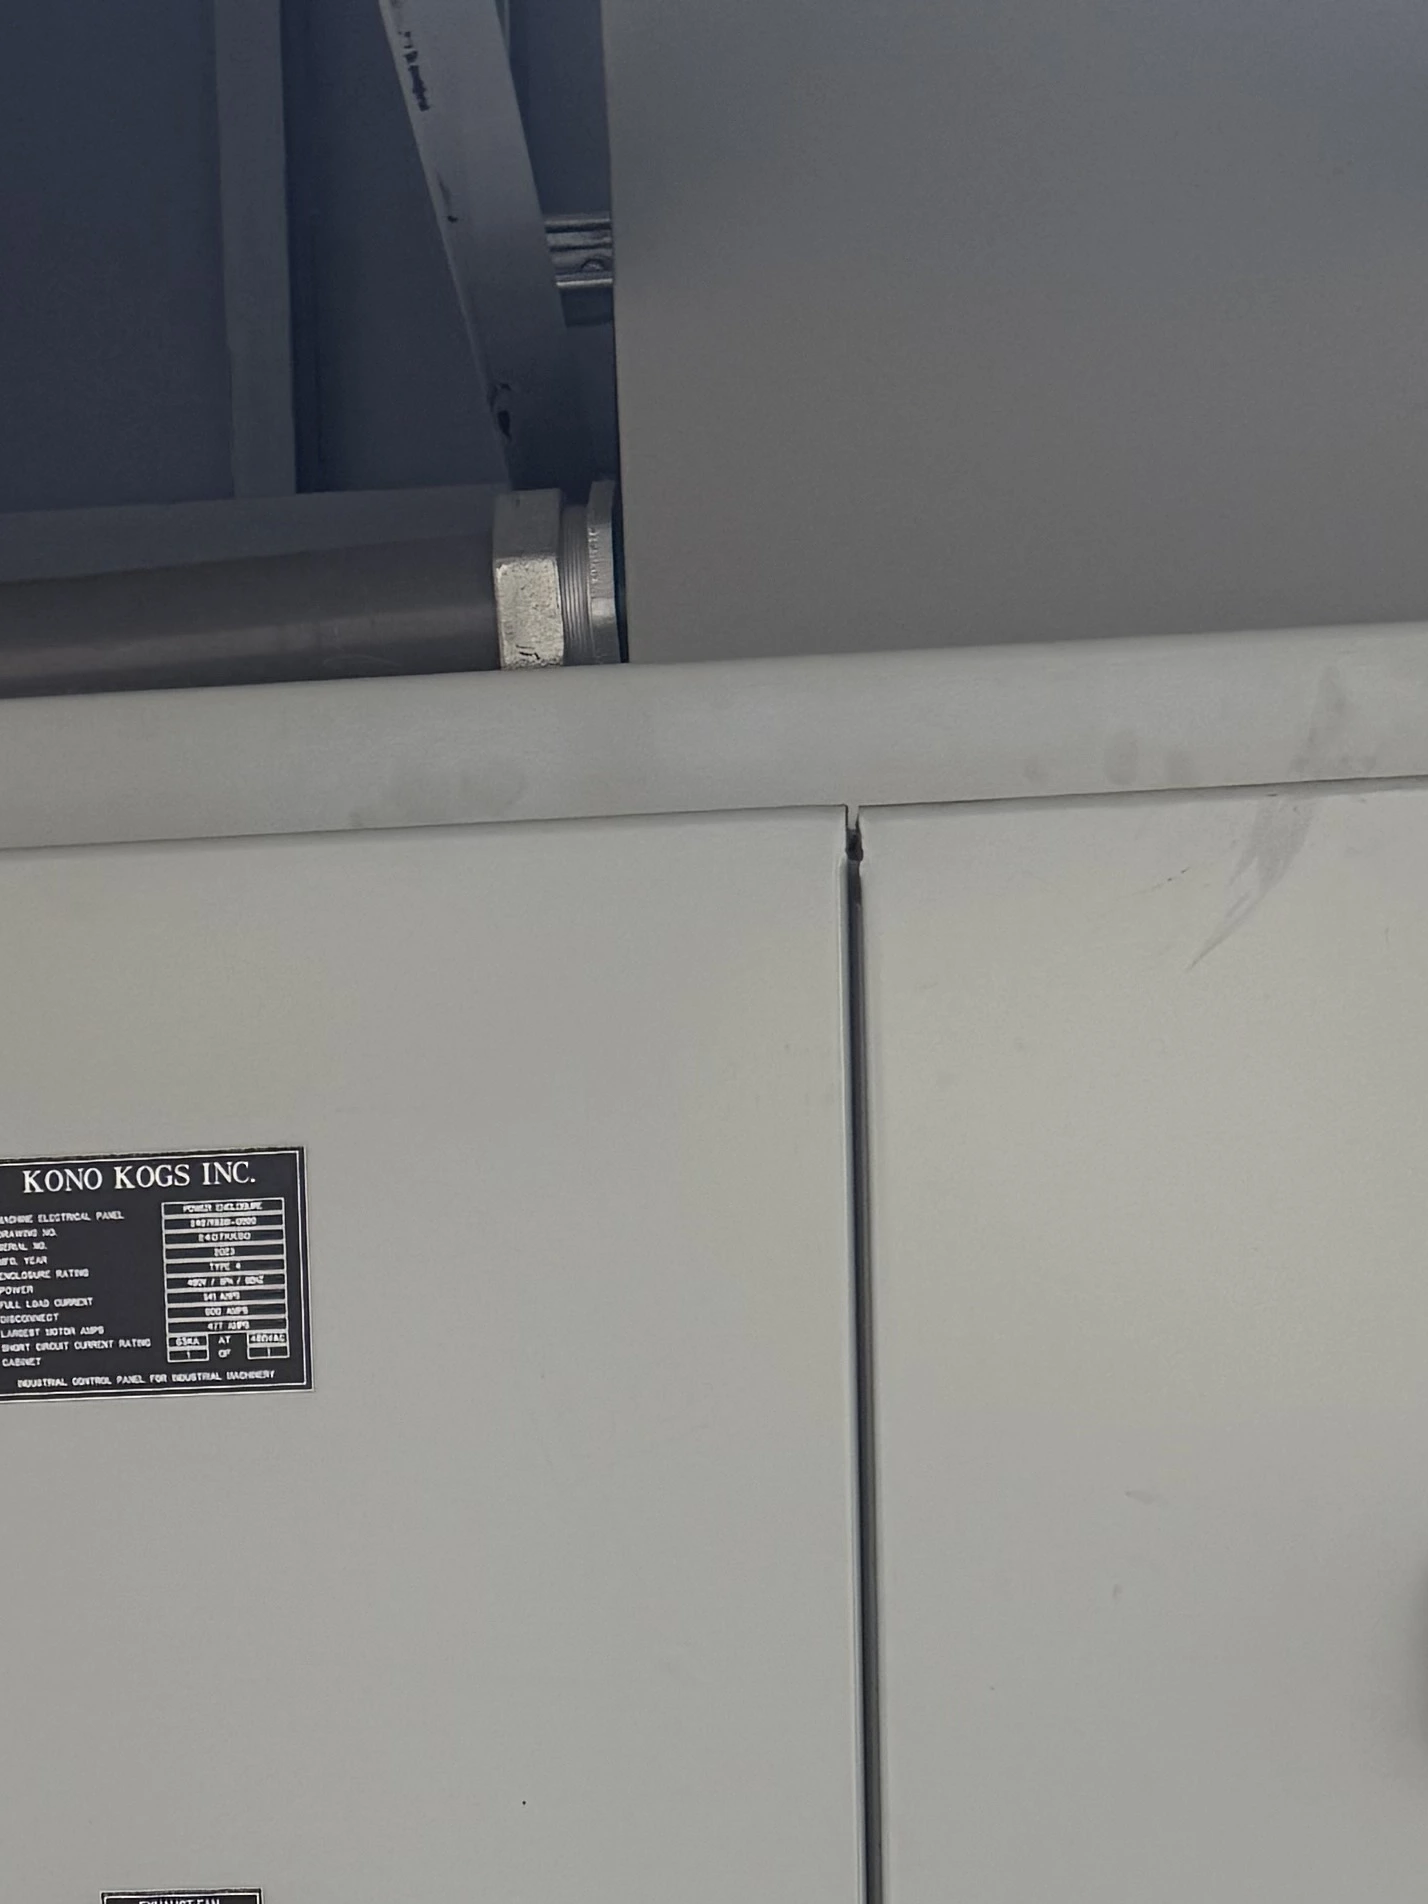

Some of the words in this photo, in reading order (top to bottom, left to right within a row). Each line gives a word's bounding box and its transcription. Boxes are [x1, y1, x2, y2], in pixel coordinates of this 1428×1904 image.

[22, 1168, 103, 1193] KONO
[113, 1164, 190, 1189] KOGS
[202, 1161, 256, 1186] INC.
[38, 1212, 91, 1222] ELECTRICAL
[96, 1210, 124, 1220] PANEL
[24, 1256, 48, 1265] YEAR
[56, 1268, 89, 1278] RATING
[0, 1285, 33, 1295] POWER
[0, 1300, 22, 1310] FULL
[26, 1299, 50, 1309] LOAD
[54, 1297, 93, 1307] CURRENT
[0, 1313, 59, 1324] DISCONNECT
[1, 1328, 40, 1338] LARGEST
[45, 1327, 76, 1336] MOTOR
[80, 1326, 105, 1335] AMPS
[2, 1343, 30, 1353] SHORT
[36, 1341, 69, 1351] CIRCUIT
[74, 1340, 114, 1350] CURRENT
[119, 1338, 151, 1348] RATING
[218, 1336, 231, 1344] AT
[218, 1349, 231, 1358] OF
[2, 1358, 41, 1367] CABINET
[18, 1377, 67, 1388] INDUSTRIAL
[72, 1376, 112, 1386] CONTROL
[116, 1374, 146, 1384] PANEL
[150, 1374, 167, 1383] FOR
[172, 1372, 222, 1382] INDUSTRIAL
